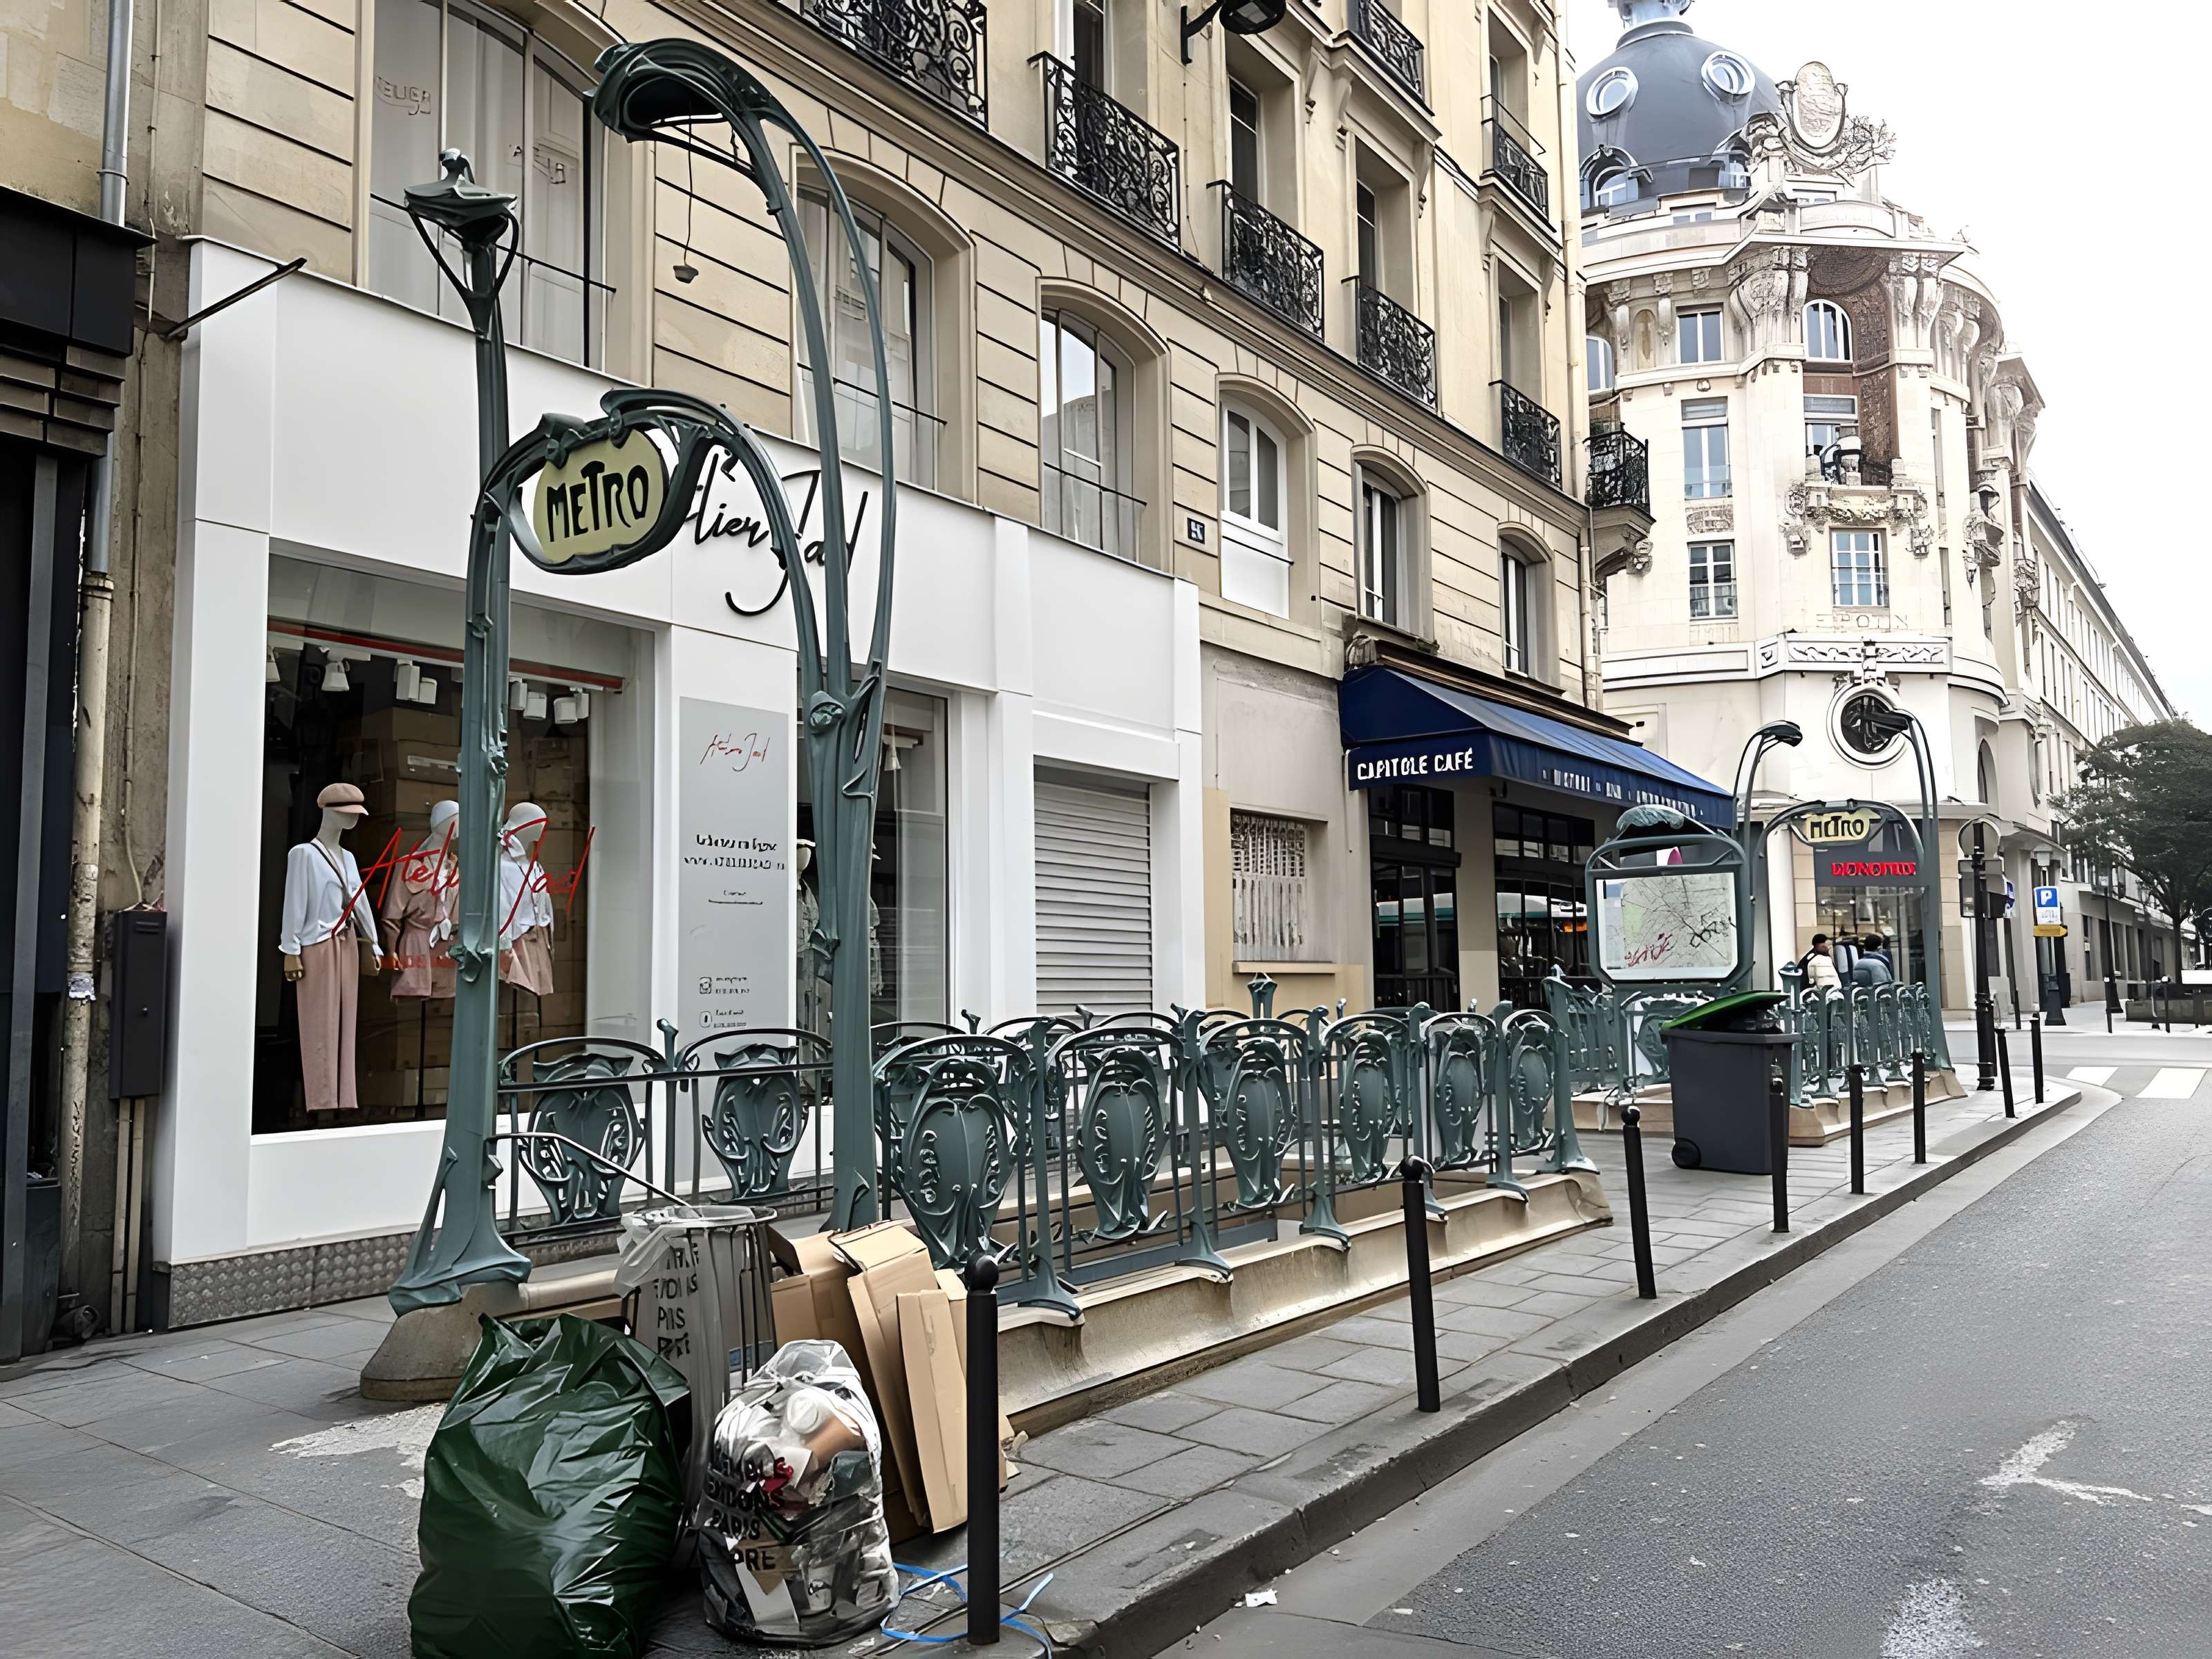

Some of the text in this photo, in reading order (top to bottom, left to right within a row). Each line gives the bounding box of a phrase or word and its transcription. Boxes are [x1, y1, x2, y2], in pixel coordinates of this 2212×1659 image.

[546, 460, 649, 543] METRO
[1357, 747, 1474, 780] CAPITOLE CAFÉ
